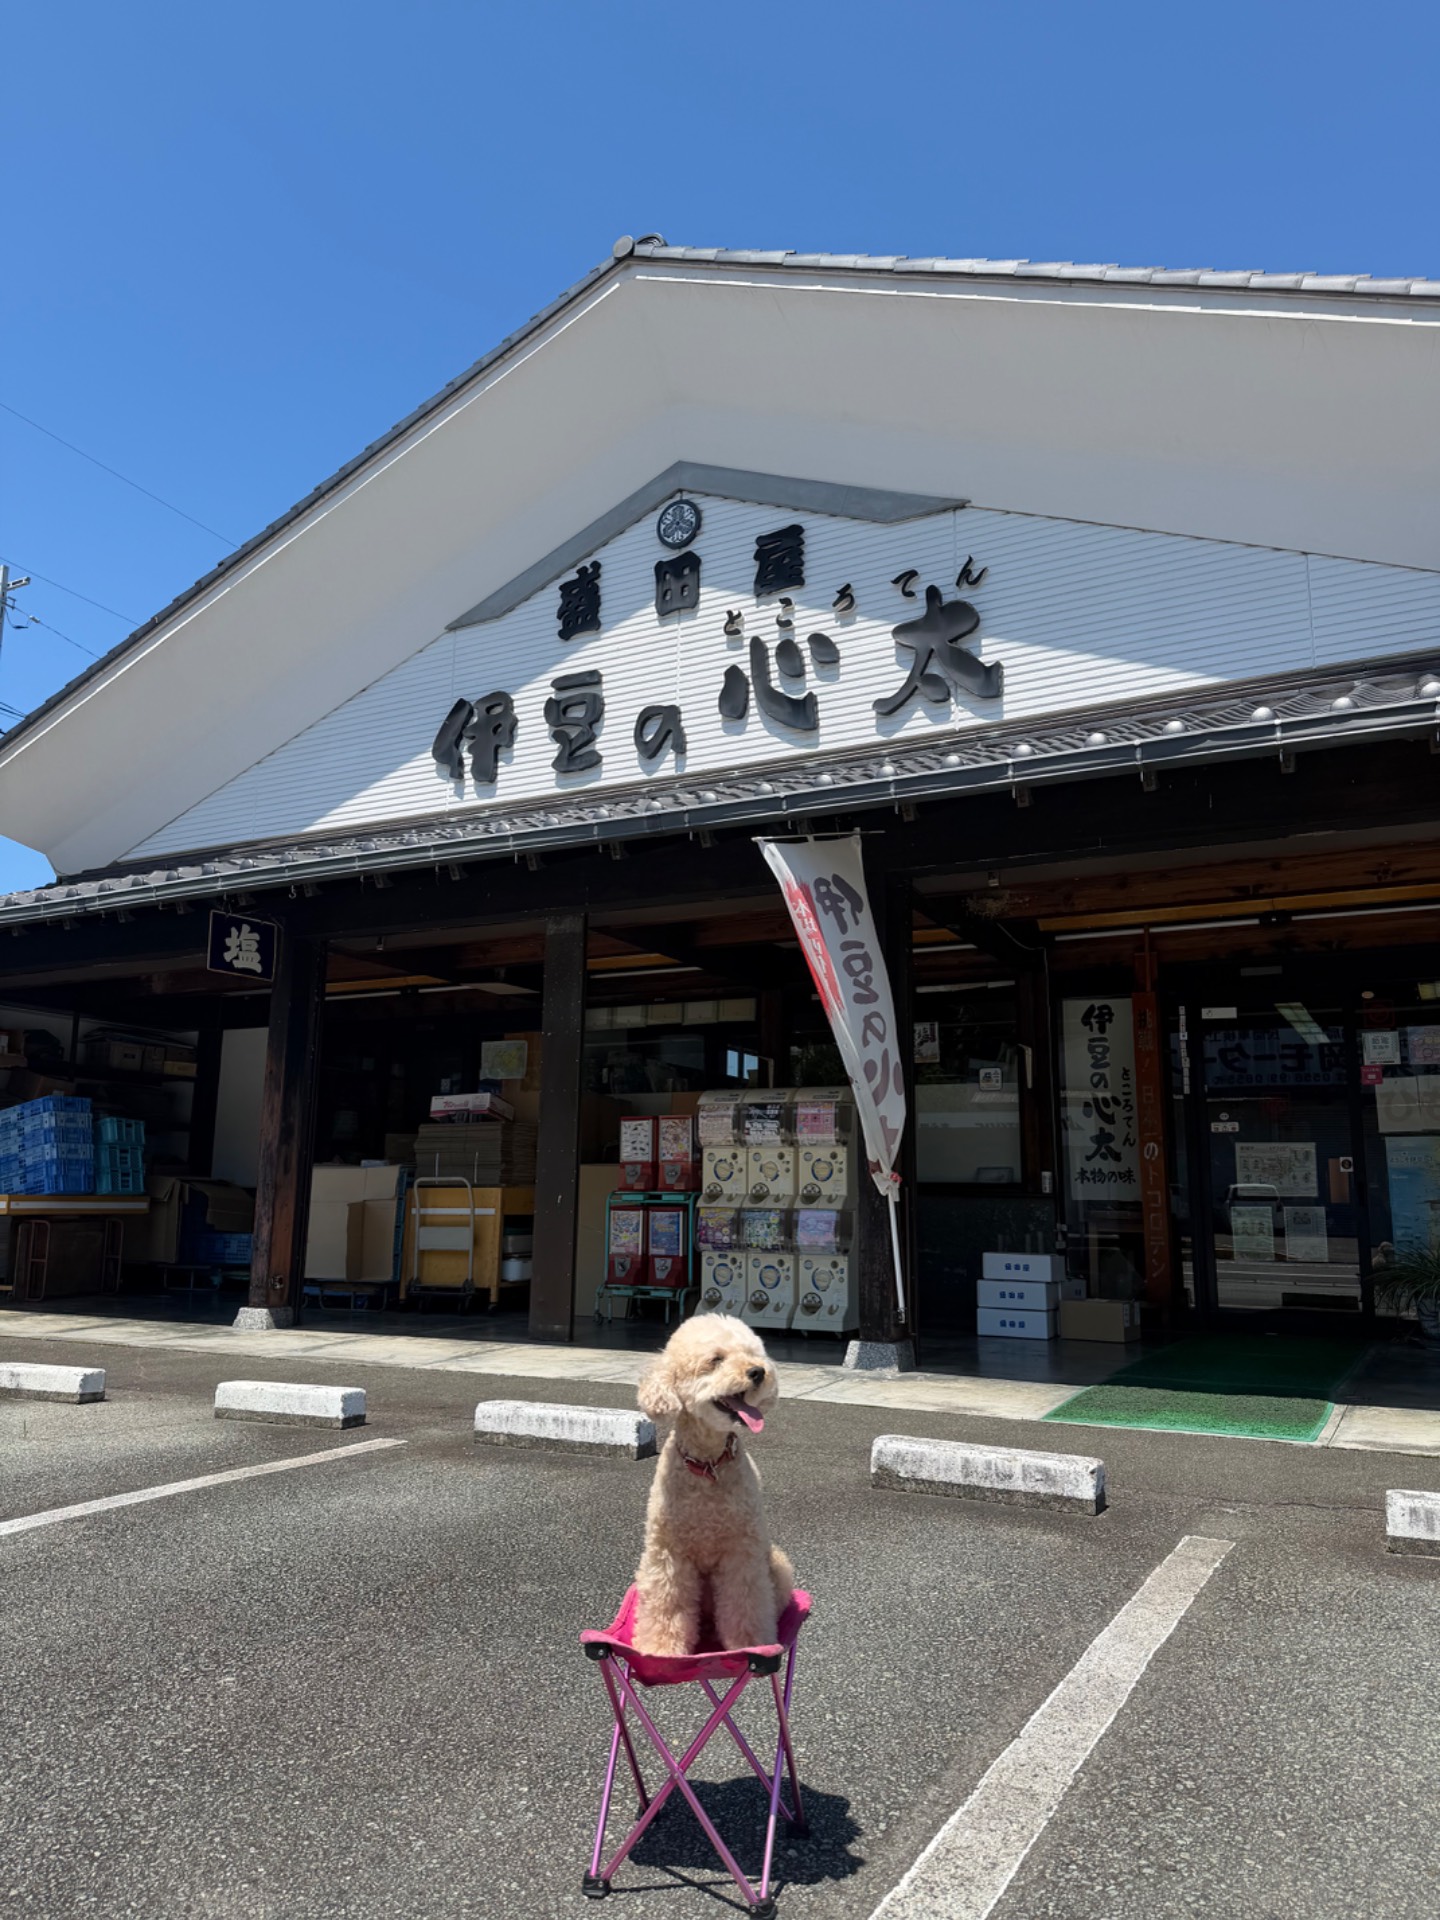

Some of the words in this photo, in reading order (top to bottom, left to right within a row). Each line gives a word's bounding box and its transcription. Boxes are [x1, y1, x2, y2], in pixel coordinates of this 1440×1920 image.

[724, 555, 989, 636] ところてん
[431, 585, 1004, 783] 伊豆の心太
[222, 923, 263, 974] 塩
[1081, 1003, 1122, 1162] 伊豆の心太
[1120, 1067, 1136, 1147] ところてん
[1074, 1167, 1137, 1185] 本物の味
